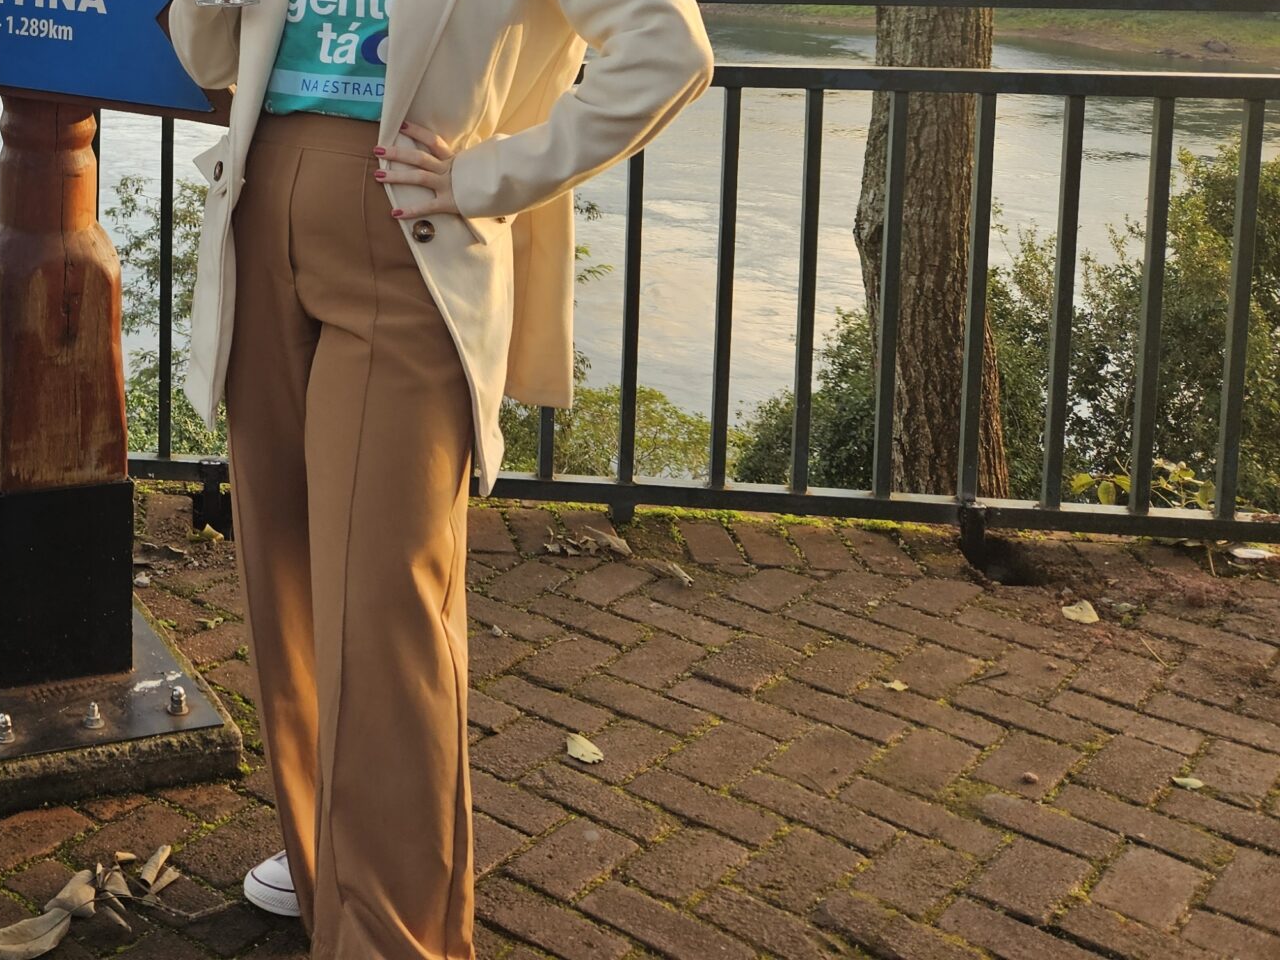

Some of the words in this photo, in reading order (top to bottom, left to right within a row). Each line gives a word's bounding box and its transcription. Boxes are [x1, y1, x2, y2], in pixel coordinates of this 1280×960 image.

[6, 15, 73, 41] 1.289km
[317, 22, 362, 65] tá
[301, 79, 319, 92] NA
